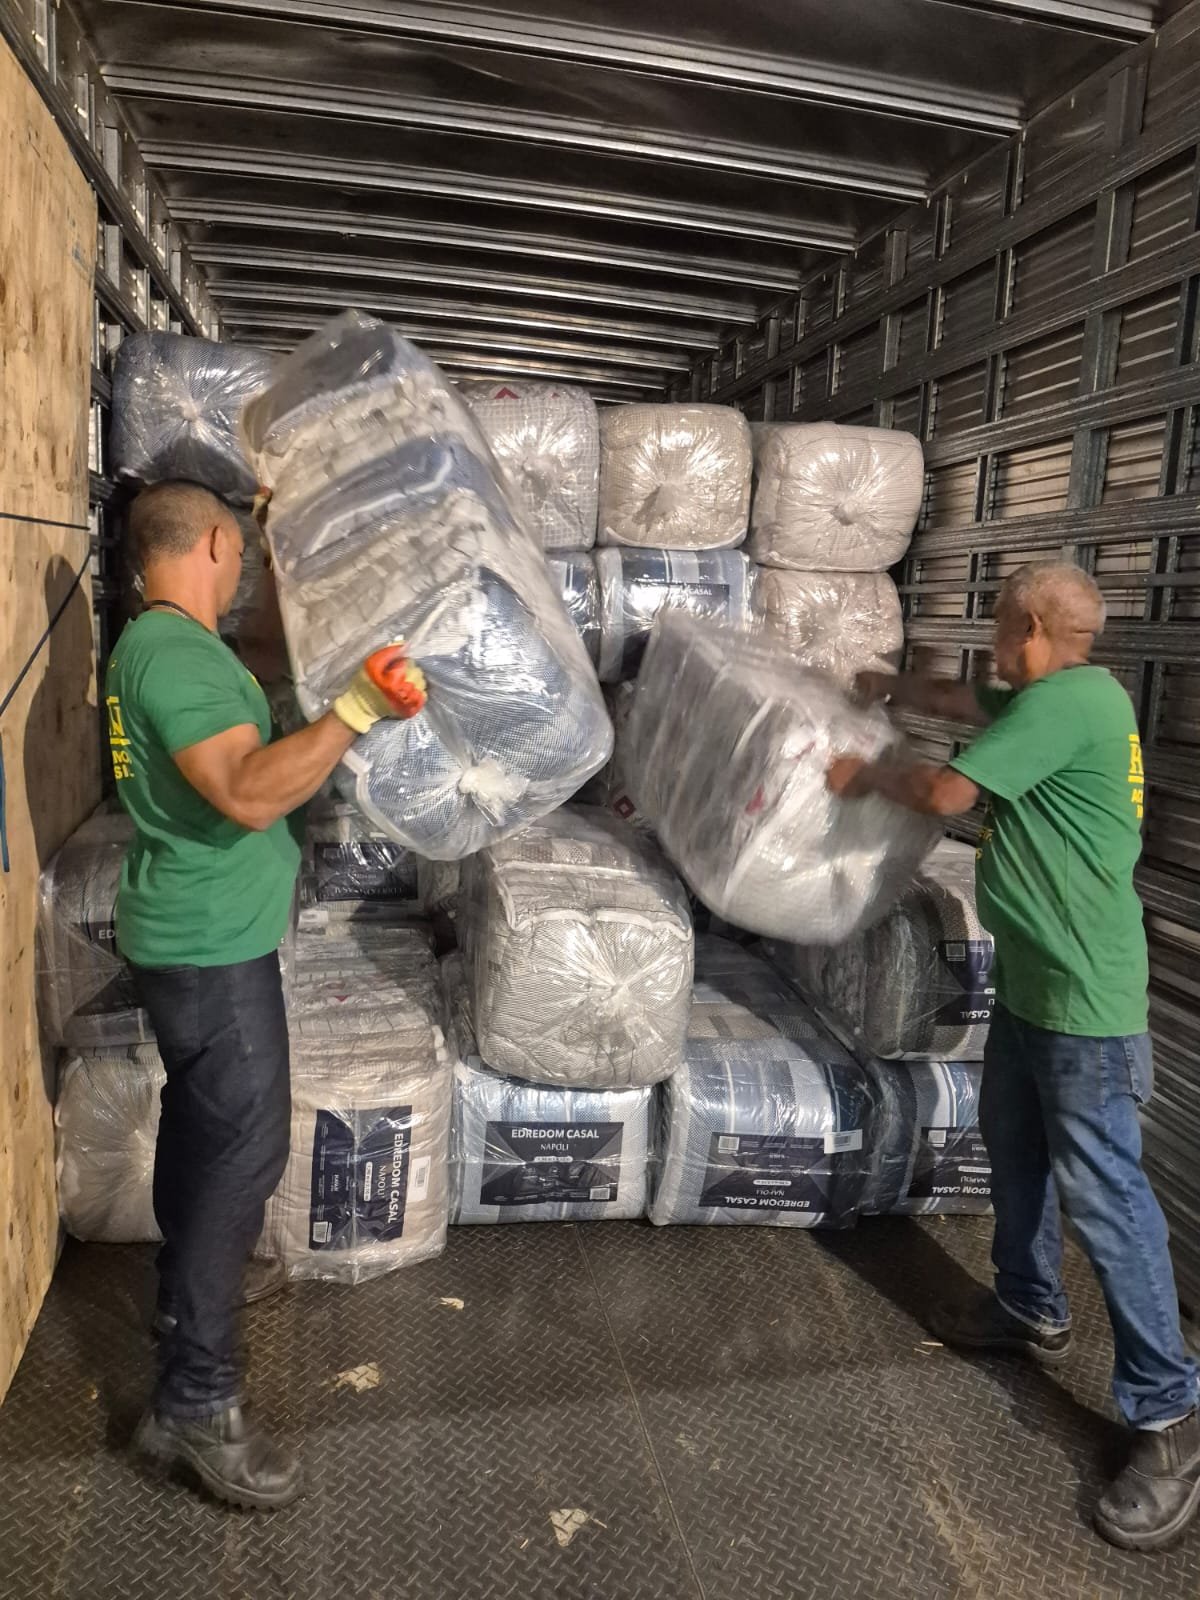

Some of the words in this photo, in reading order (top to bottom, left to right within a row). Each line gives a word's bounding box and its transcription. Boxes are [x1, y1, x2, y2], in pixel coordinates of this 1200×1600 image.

[959, 1010, 991, 1019] CASAL
[511, 1128, 565, 1139] EDREDOM
[566, 1129, 600, 1139] CASAL
[540, 1142, 569, 1151] NAPOLI
[391, 1133, 404, 1186] EDREDOM
[931, 1186, 961, 1194] CASAL
[724, 1196, 758, 1205] CASAL
[759, 1198, 811, 1208] EDREDOM
[387, 1190, 400, 1223] CASAL
